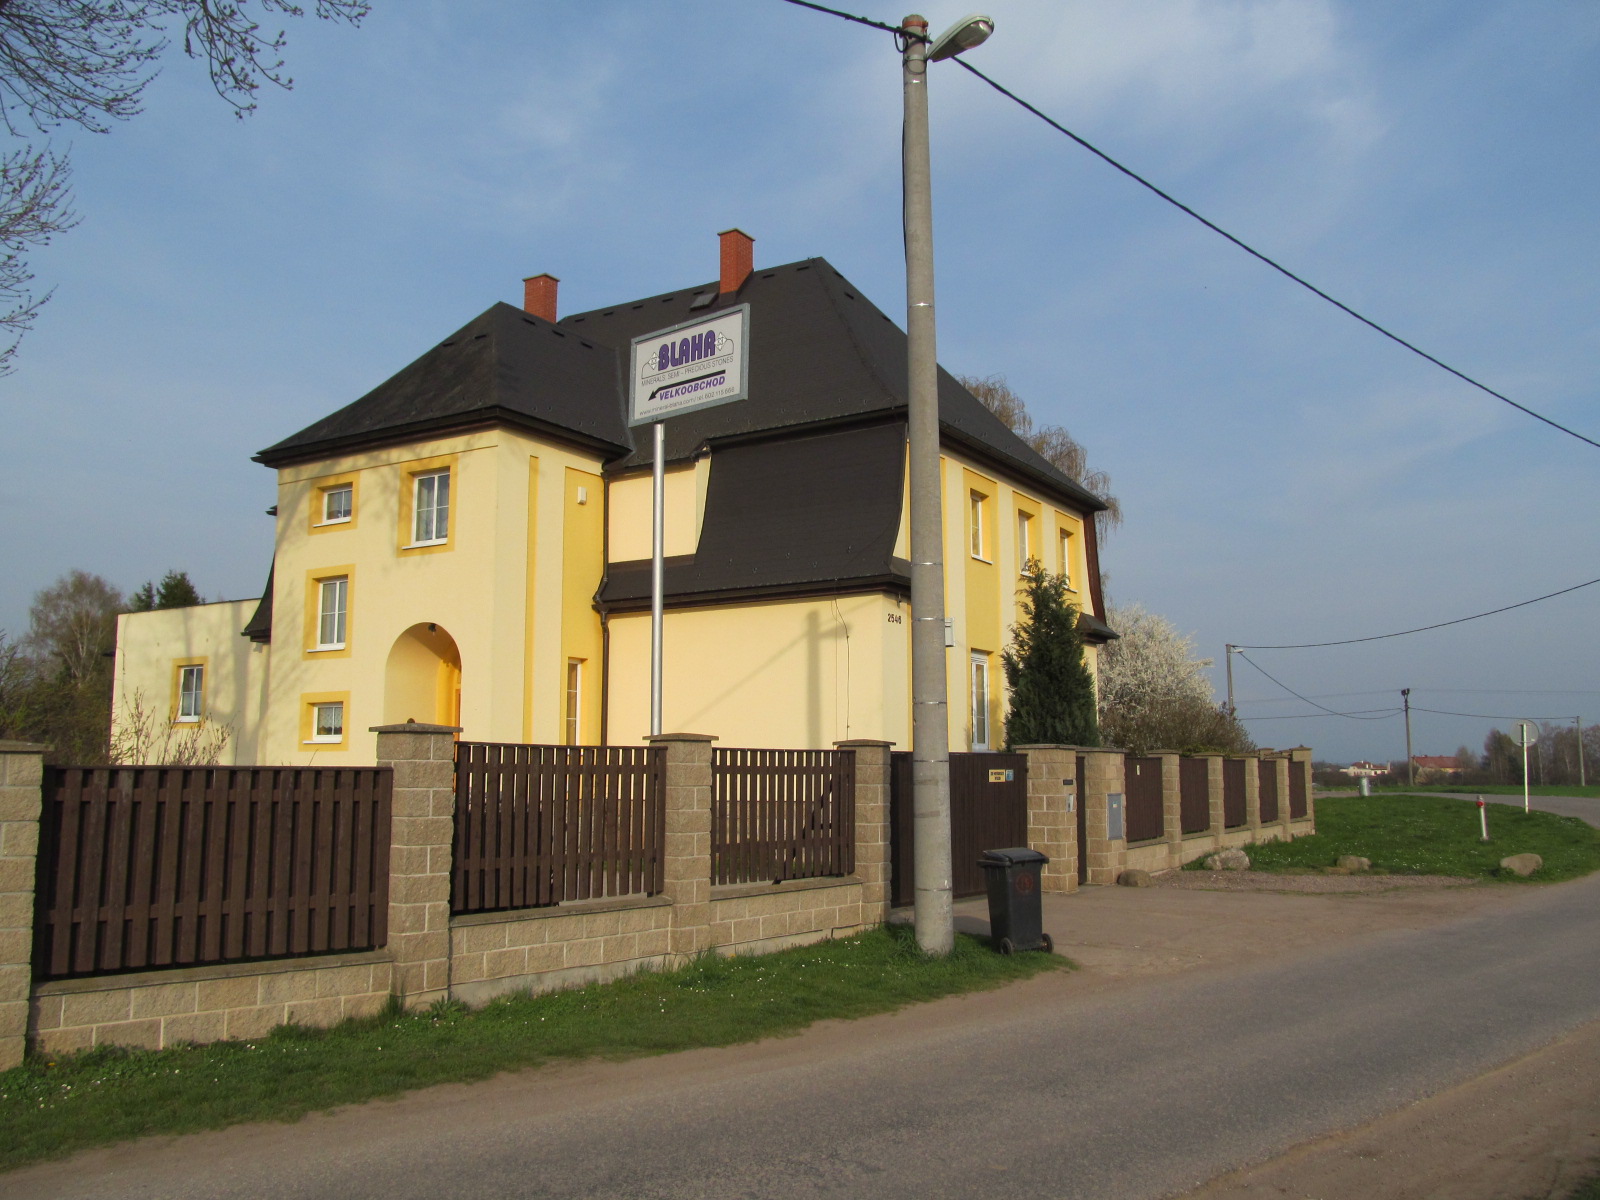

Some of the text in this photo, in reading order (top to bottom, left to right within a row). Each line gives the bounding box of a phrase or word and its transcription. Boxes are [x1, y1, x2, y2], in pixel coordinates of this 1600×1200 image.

[658, 330, 715, 371] BLAHA
[685, 364, 711, 375] PRECIOUS
[712, 356, 733, 367] STONES
[659, 376, 725, 400] VELKOOBCHOD
